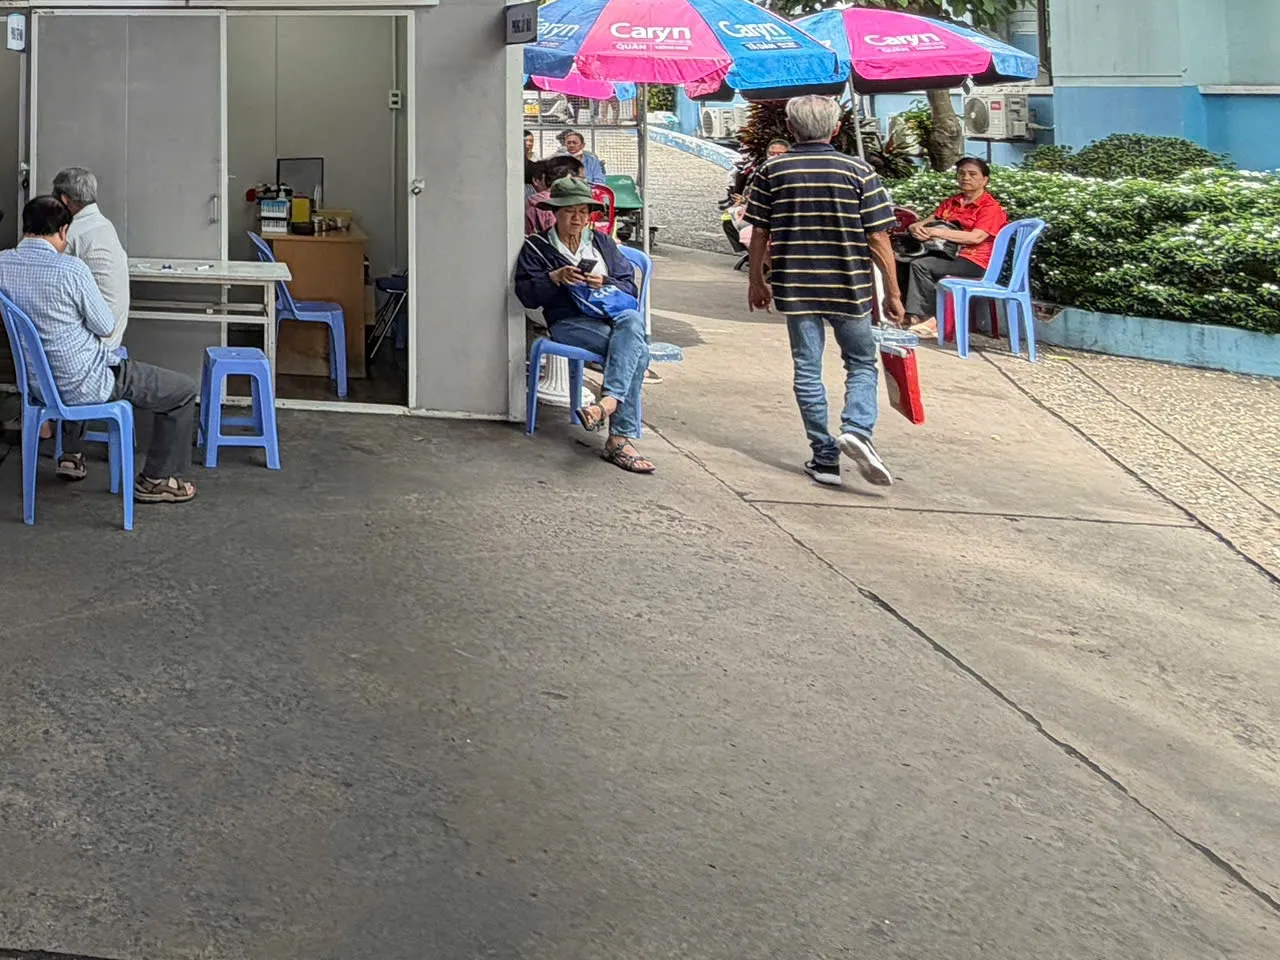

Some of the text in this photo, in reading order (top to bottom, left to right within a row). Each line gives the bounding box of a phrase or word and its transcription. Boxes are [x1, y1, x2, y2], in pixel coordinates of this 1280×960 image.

[538, 19, 581, 39] aryn
[609, 22, 692, 43] Caryn
[718, 20, 787, 41] Caryn
[863, 32, 941, 47] Caryn
